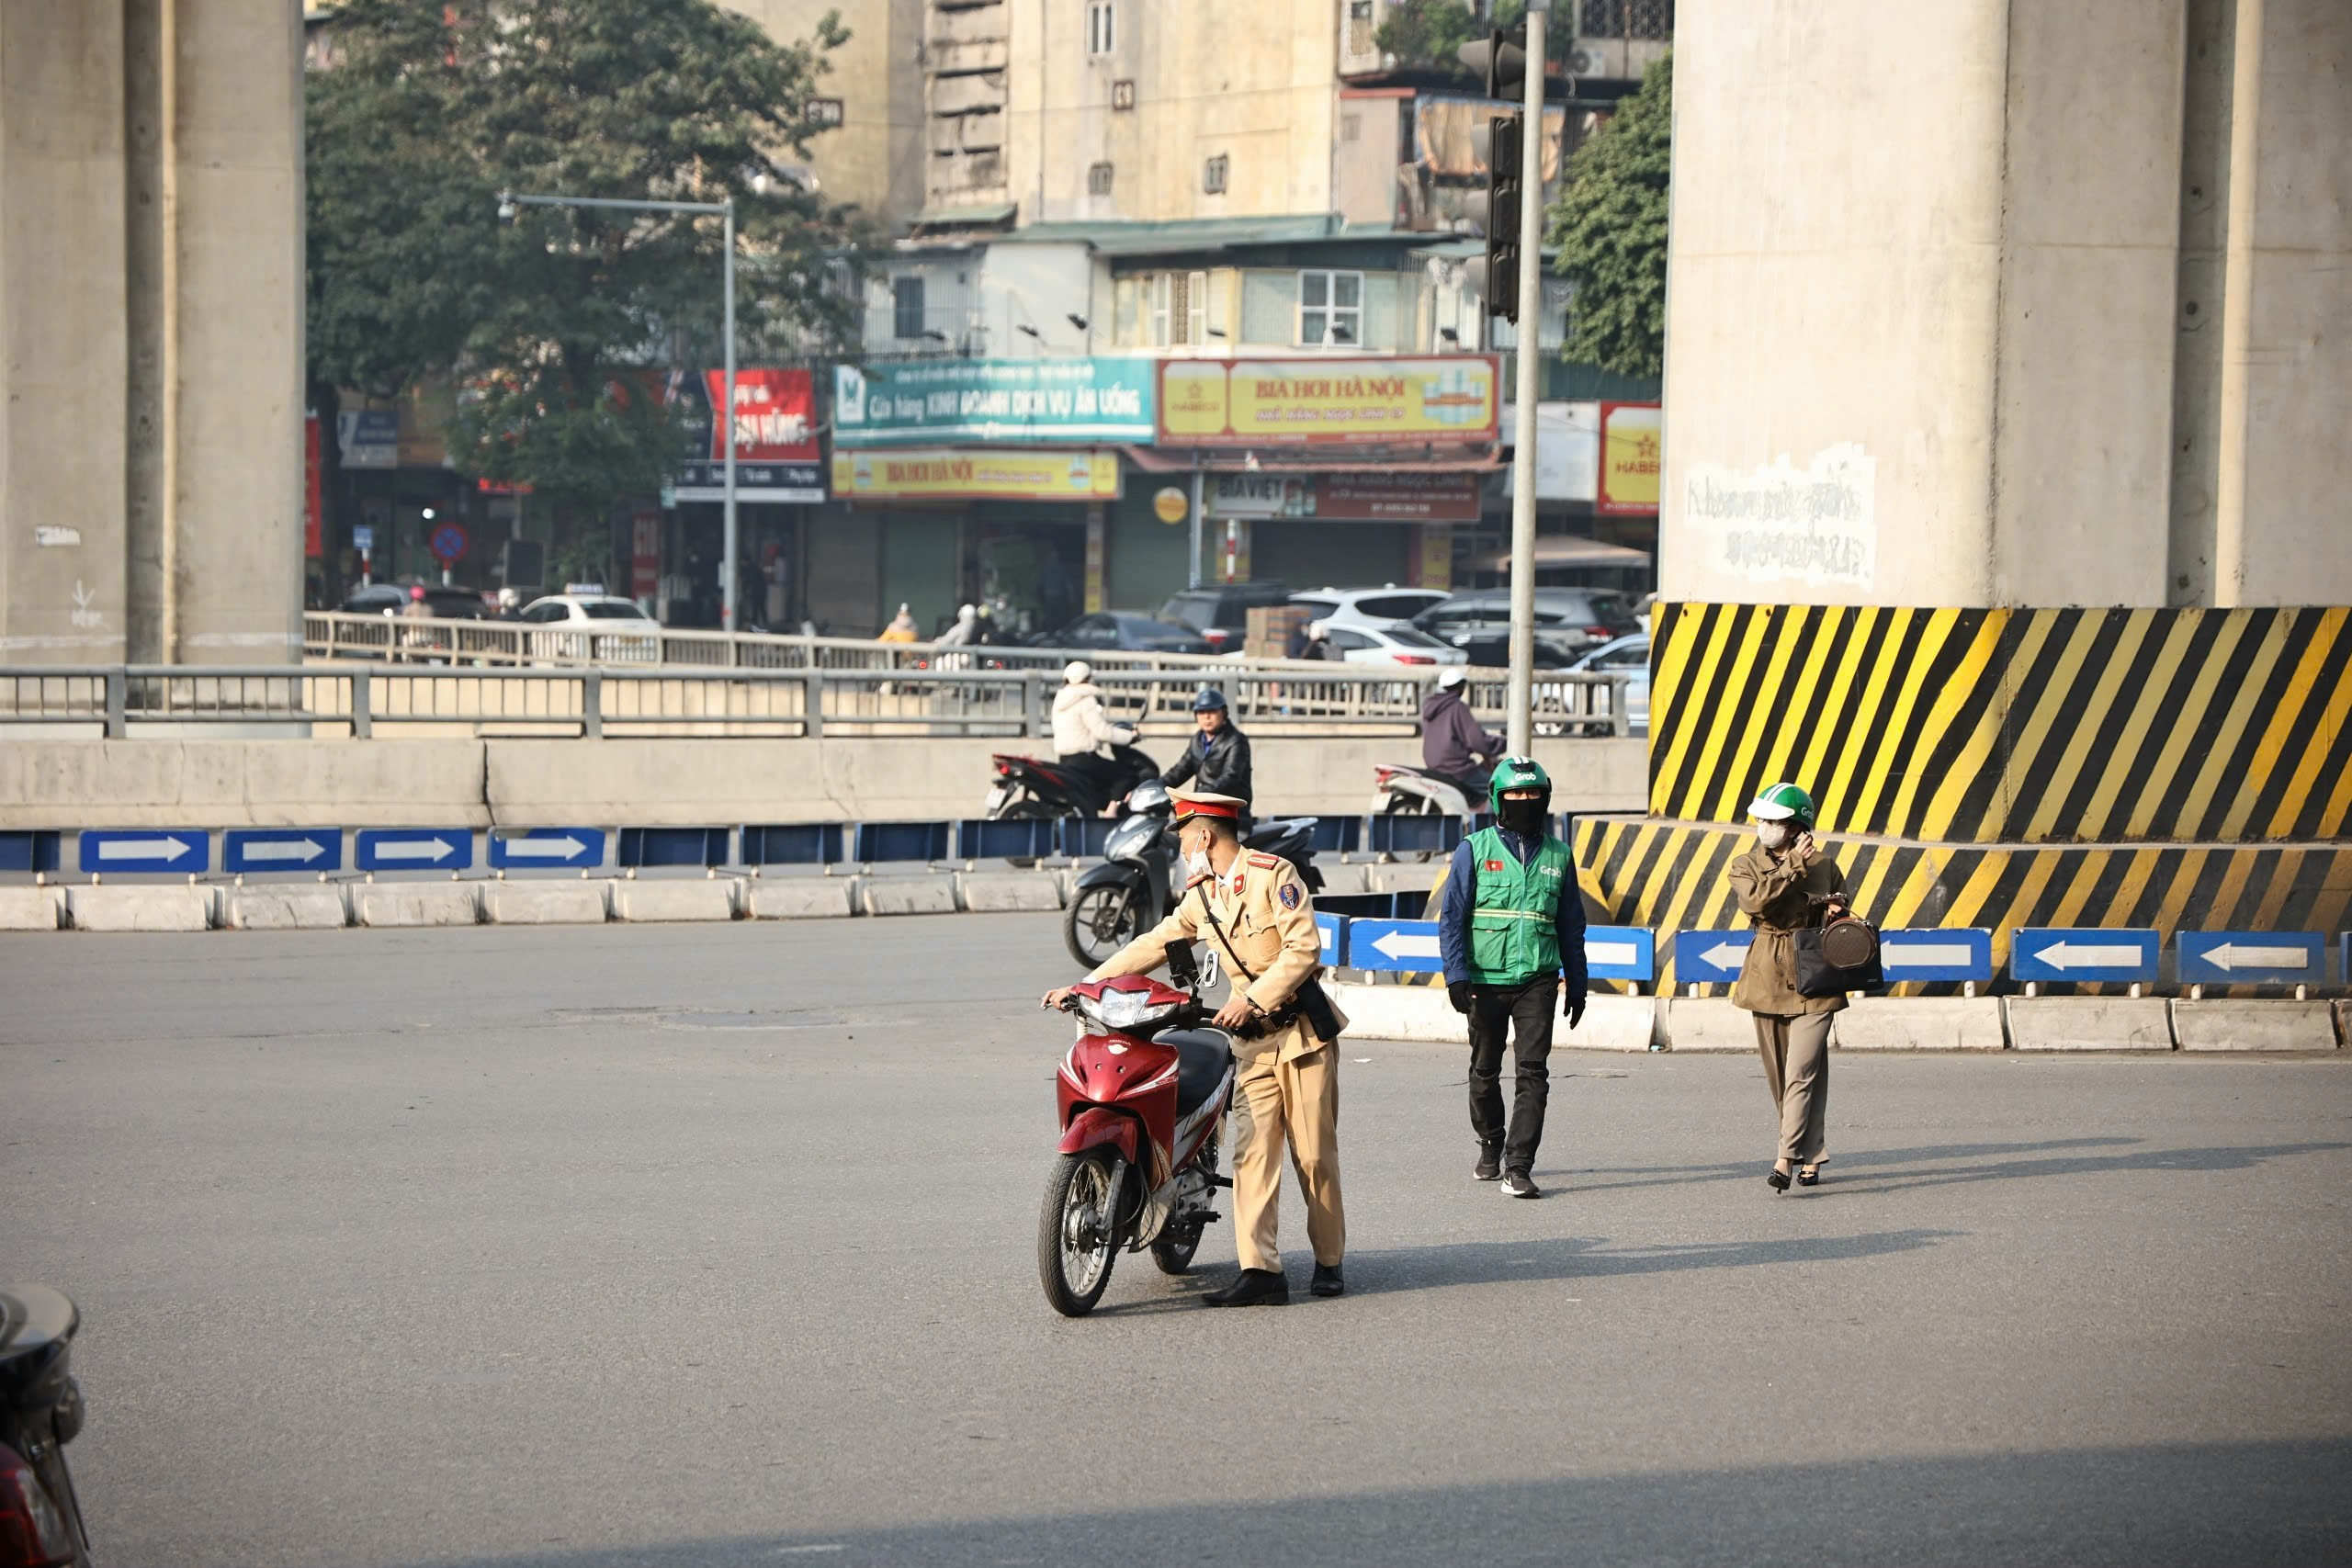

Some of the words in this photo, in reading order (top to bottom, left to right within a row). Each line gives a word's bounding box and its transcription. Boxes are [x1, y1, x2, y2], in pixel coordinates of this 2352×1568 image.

[1256, 379, 1289, 398] BIA
[1336, 375, 1364, 398] HÀ
[1368, 375, 1405, 401] NỘI
[1615, 461, 1660, 474] HABE
[1515, 772, 1537, 781] Grab
[1540, 864, 1562, 878] Grab
